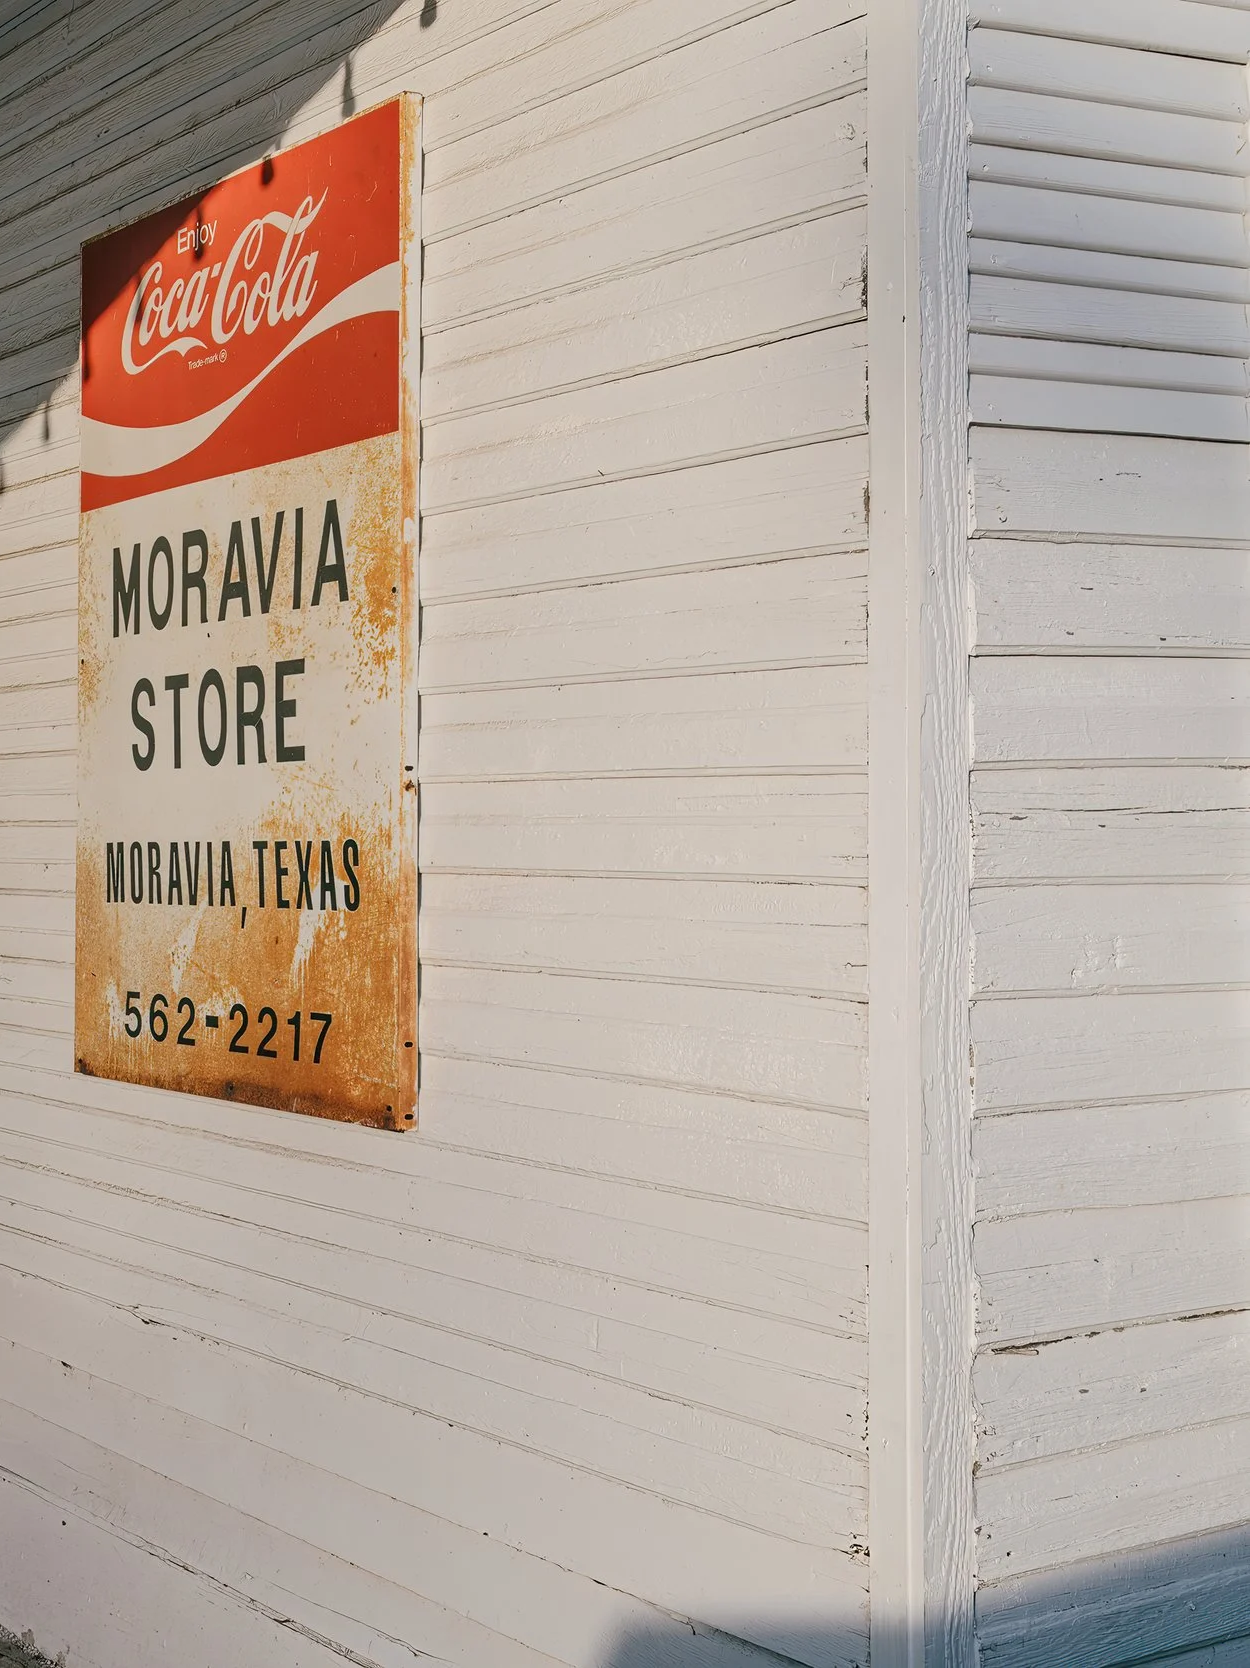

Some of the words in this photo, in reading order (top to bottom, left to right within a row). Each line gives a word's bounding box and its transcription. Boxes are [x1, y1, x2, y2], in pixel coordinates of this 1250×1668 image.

[121, 187, 329, 376] Coca-Cola
[176, 218, 218, 255] Enjoy
[112, 499, 350, 638] MORAVIA
[130, 657, 306, 772] STORE
[252, 838, 361, 912] TEXAS
[123, 991, 333, 1064] 562-2217
